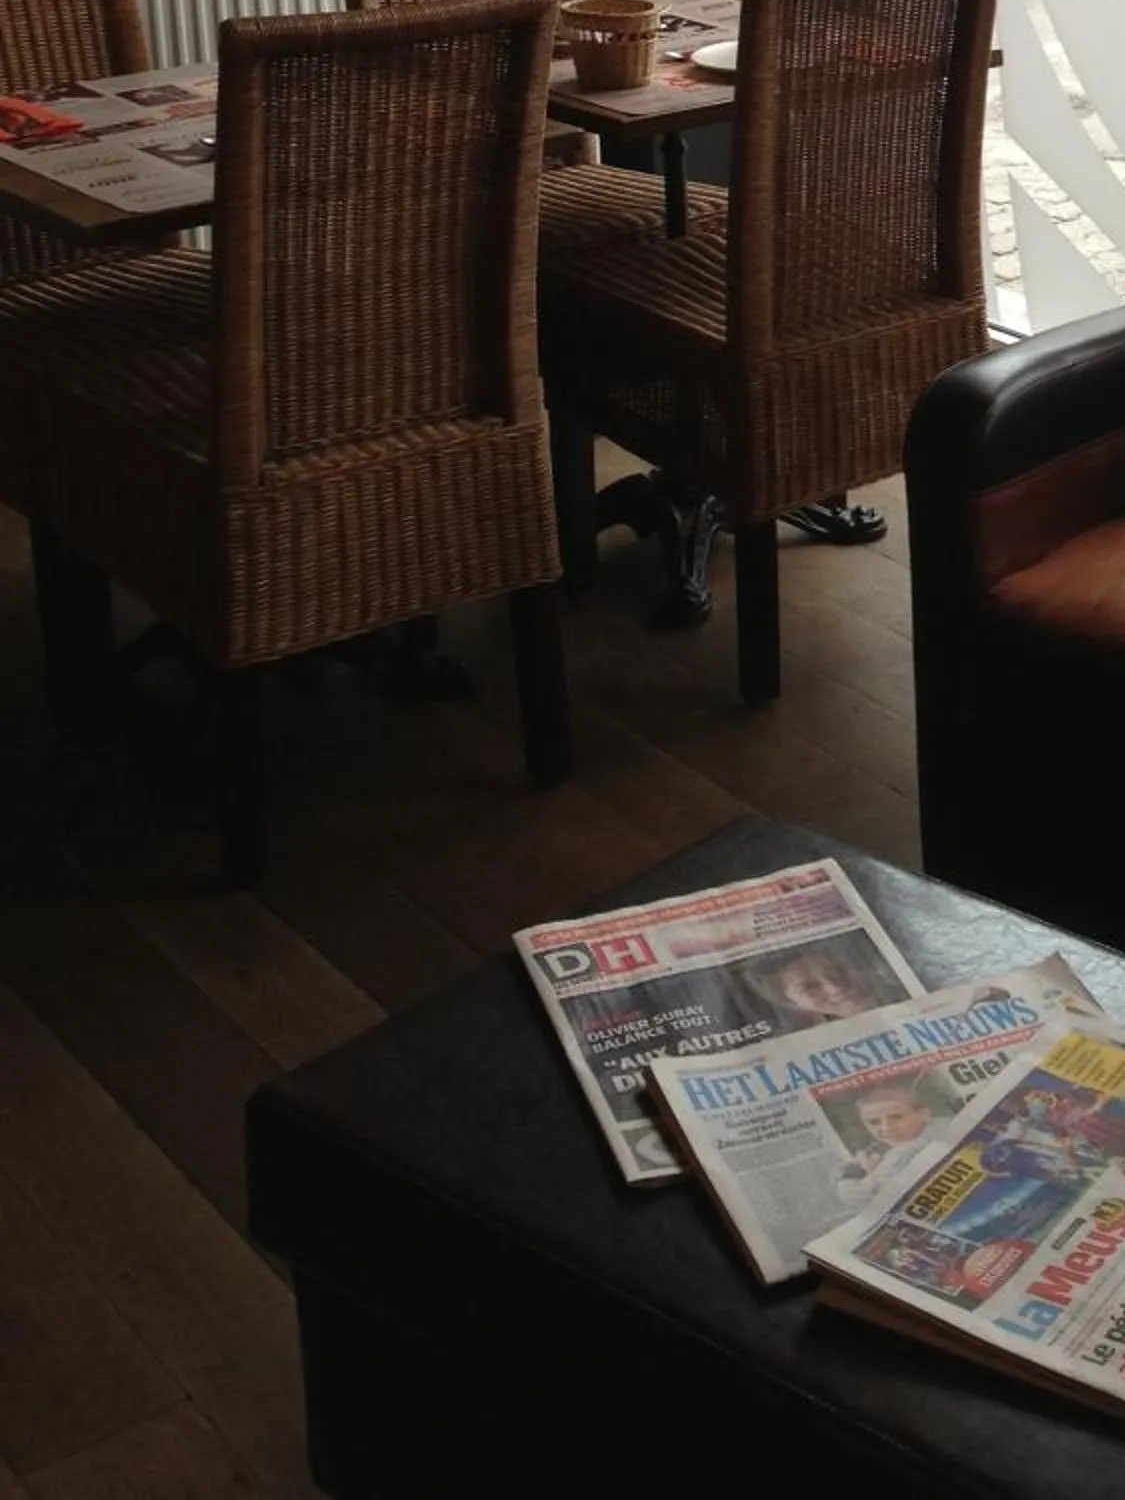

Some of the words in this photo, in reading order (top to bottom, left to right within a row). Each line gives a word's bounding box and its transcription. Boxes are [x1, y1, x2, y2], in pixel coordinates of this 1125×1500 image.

[543, 937, 649, 980] DH
[586, 1018, 650, 1043] OLIVIER
[592, 1026, 667, 1053] BALANCE
[676, 1020, 772, 1055] AUTRES
[903, 996, 1039, 1052] NIEUWS
[905, 1159, 975, 1220] GRATUIT
[1081, 1343, 1117, 1366] Le
